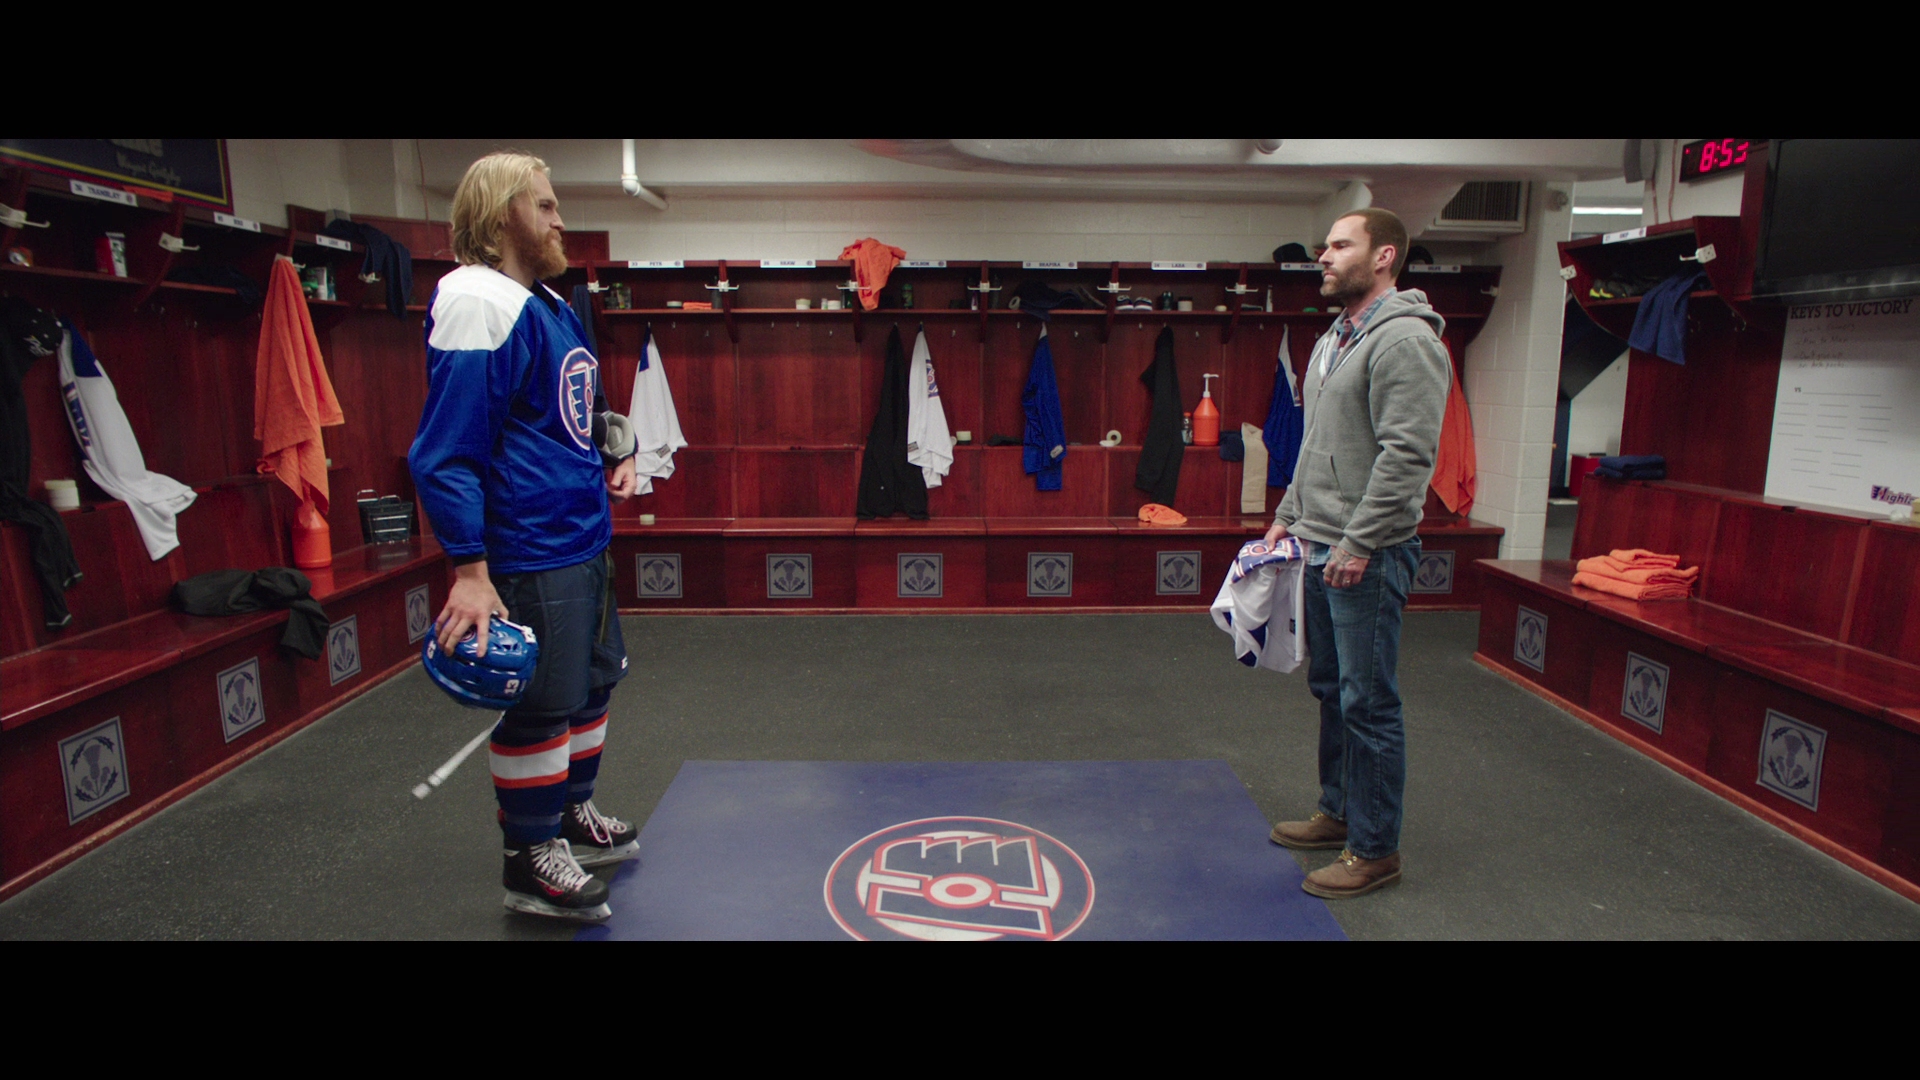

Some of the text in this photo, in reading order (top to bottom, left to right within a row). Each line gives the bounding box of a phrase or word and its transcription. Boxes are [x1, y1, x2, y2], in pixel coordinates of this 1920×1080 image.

[1790, 299, 1913, 320] KEYS TO VICTORY
